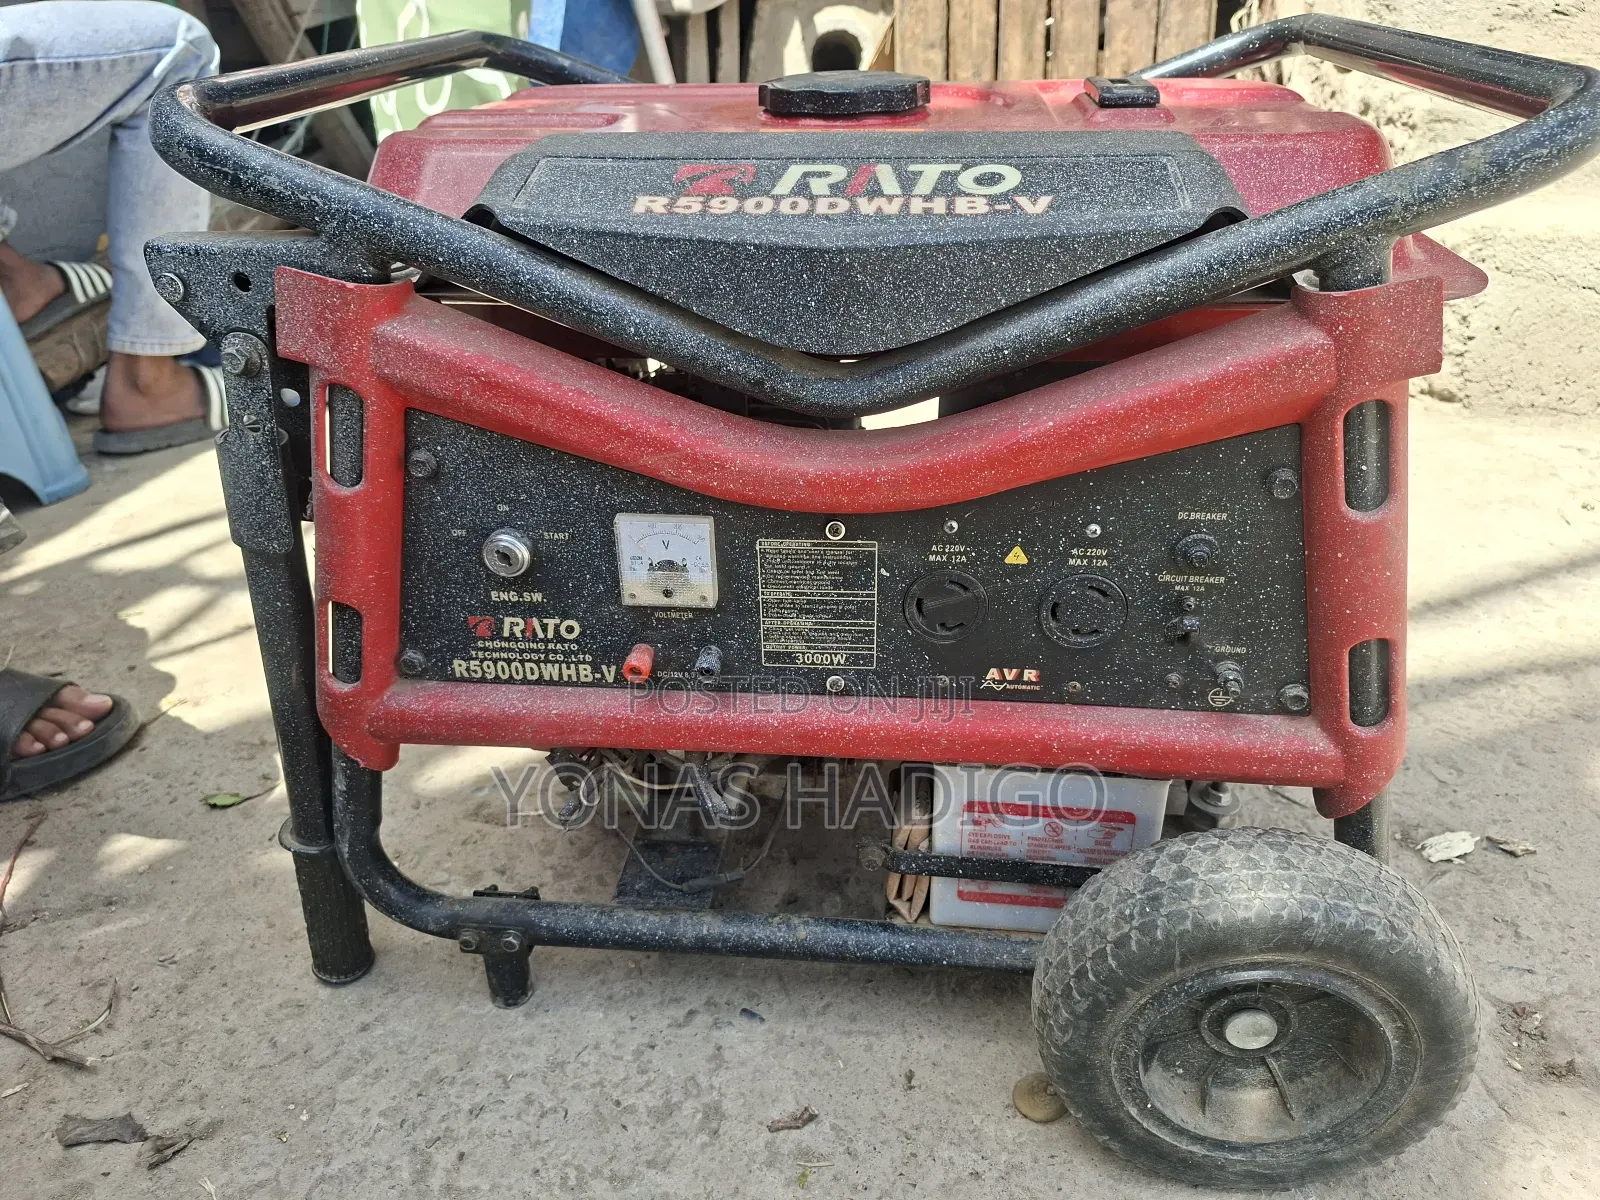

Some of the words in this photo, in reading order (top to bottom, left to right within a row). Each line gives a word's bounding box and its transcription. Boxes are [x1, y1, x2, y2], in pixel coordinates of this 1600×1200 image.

[770, 164, 1023, 196] RATO
[632, 195, 1053, 216] R5900DWHB-V
[496, 504, 509, 512] ON
[1190, 512, 1227, 521] BREAKER
[452, 528, 467, 537] OFF
[543, 531, 570, 540] START
[661, 539, 670, 550] V
[945, 544, 966, 552] 220V
[1072, 548, 1085, 556] AC
[1086, 548, 1108, 556] 220V
[929, 554, 947, 562] MAX
[951, 554, 967, 563] 12A
[1068, 558, 1088, 567] MAX
[1092, 559, 1108, 567] 12A
[1158, 573, 1190, 583] CIRCUIT
[1189, 575, 1225, 584] BREAKER
[654, 611, 693, 619] VOLTMETER
[503, 617, 580, 640] RATO
[477, 640, 547, 650] CHONGQING
[549, 643, 578, 651] RATO
[1215, 646, 1246, 654] GROUND
[471, 650, 547, 661] TECHNOLOGY
[796, 653, 846, 664] 3000W
[453, 660, 617, 683] R5900DWHB-V
[984, 667, 1041, 682] AVR
[1006, 683, 1041, 691] AUTOMATIC
